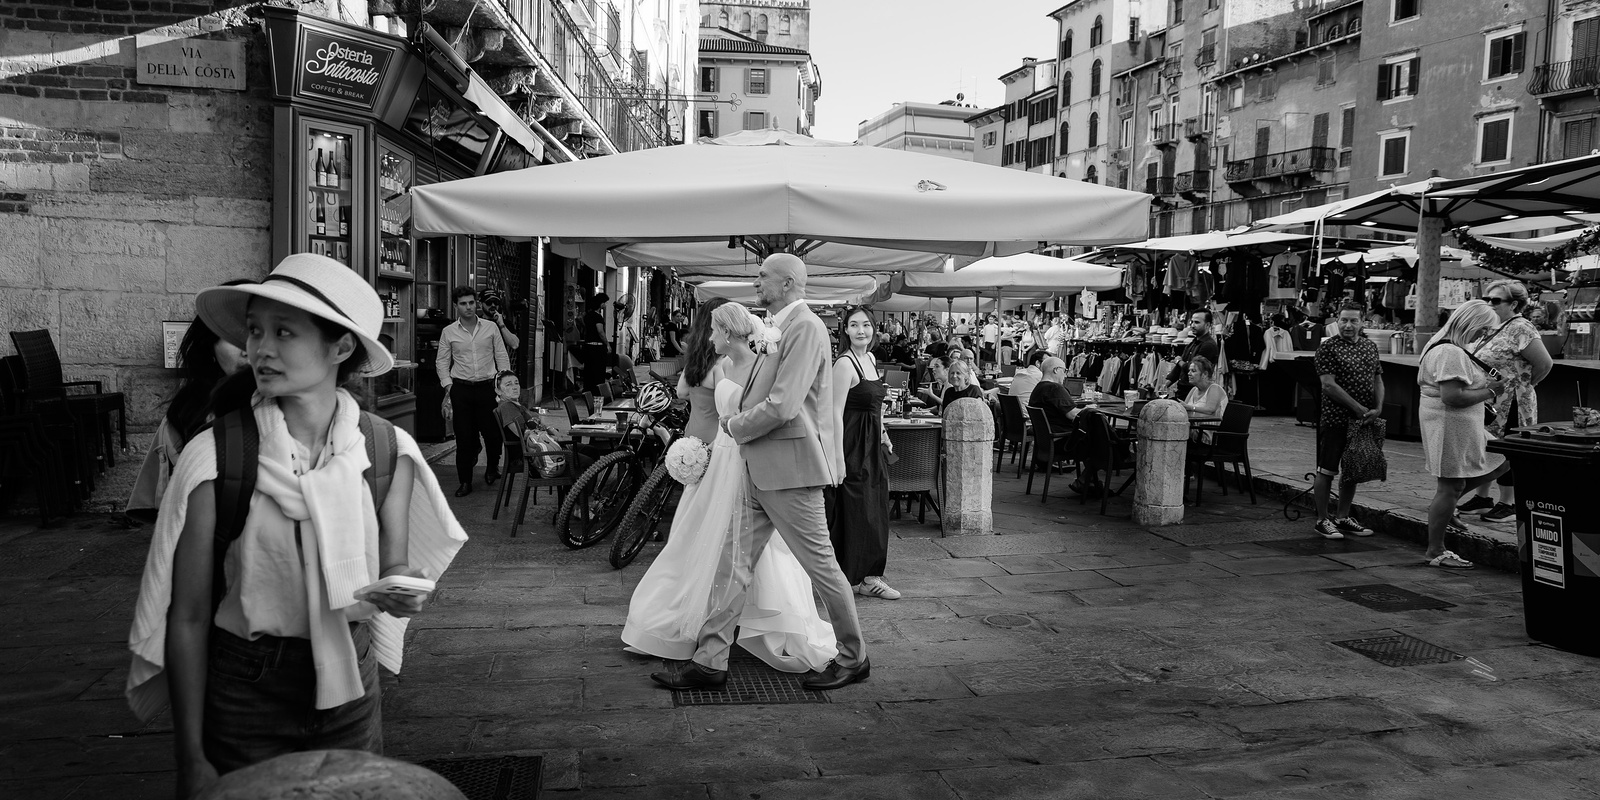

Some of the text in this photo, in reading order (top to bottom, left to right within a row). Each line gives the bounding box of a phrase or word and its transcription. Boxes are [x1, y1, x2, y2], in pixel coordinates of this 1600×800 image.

[181, 47, 202, 59] VIA
[328, 41, 373, 65] Osteria
[147, 62, 236, 79] DELLA COSTA
[306, 48, 380, 85] Sottocosta
[311, 83, 335, 93] COFFEE
[344, 90, 365, 99] BREAK
[1537, 502, 1565, 512] amia
[1536, 528, 1558, 542] UMIDO
